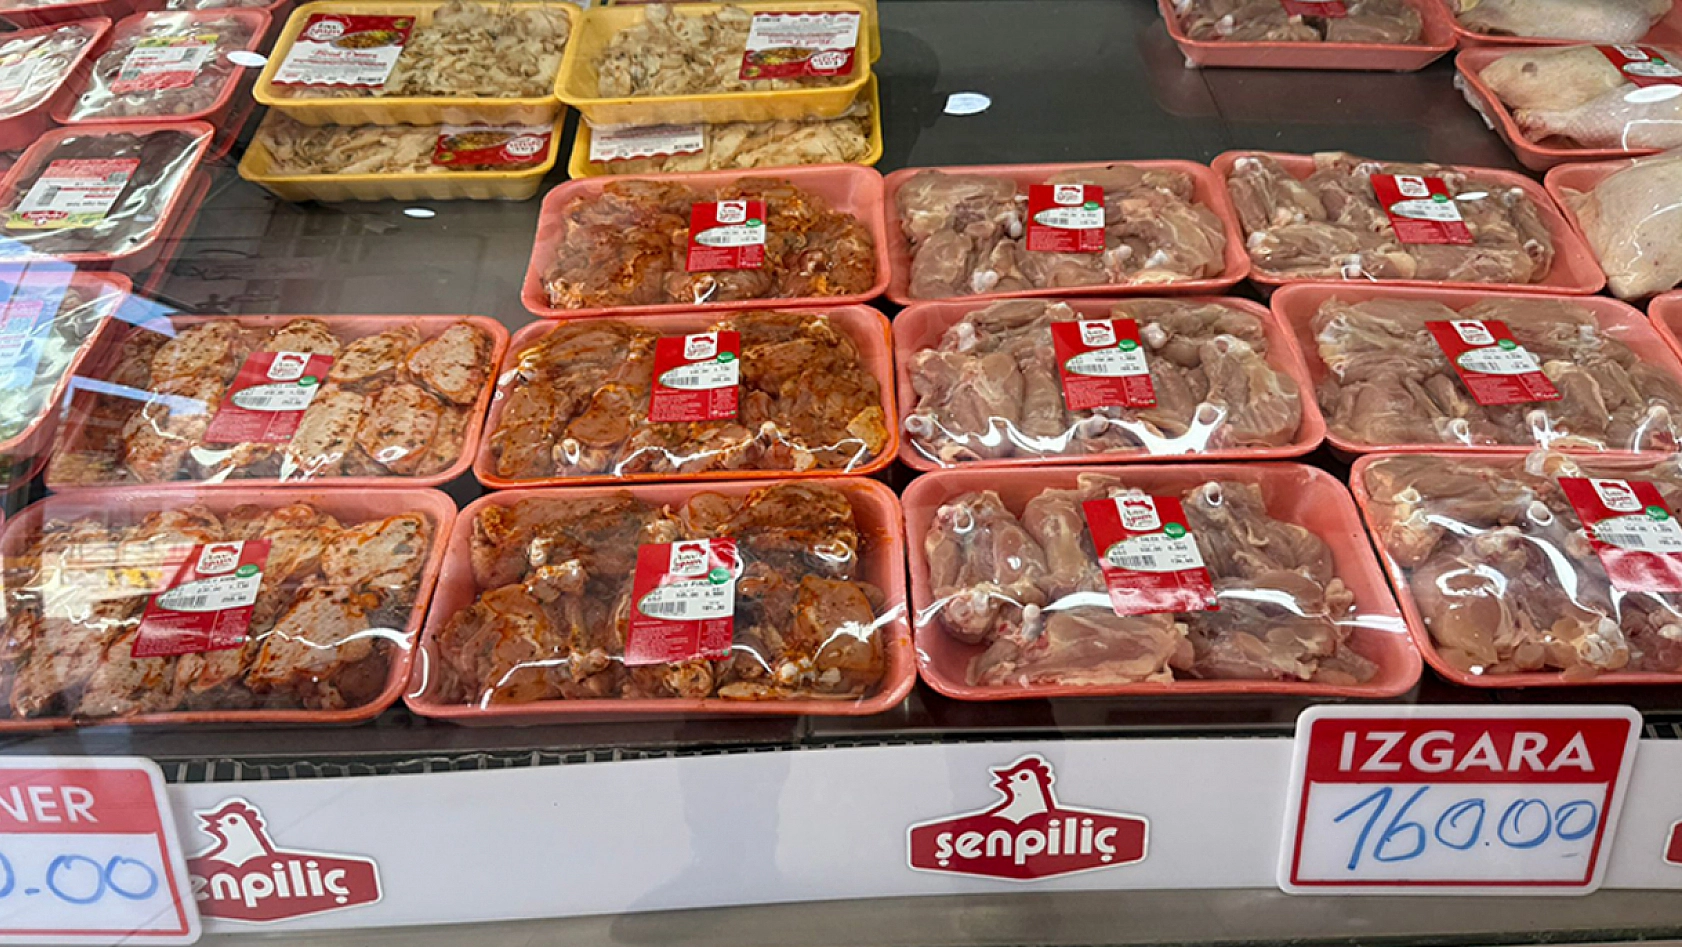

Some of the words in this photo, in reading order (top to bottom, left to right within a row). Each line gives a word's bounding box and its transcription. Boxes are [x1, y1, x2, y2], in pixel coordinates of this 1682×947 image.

[1338, 730, 1596, 773] IZGARA
[935, 817, 1118, 867] şenpiliç
[1333, 785, 1598, 871] 160.00
[0, 852, 159, 905] .00
